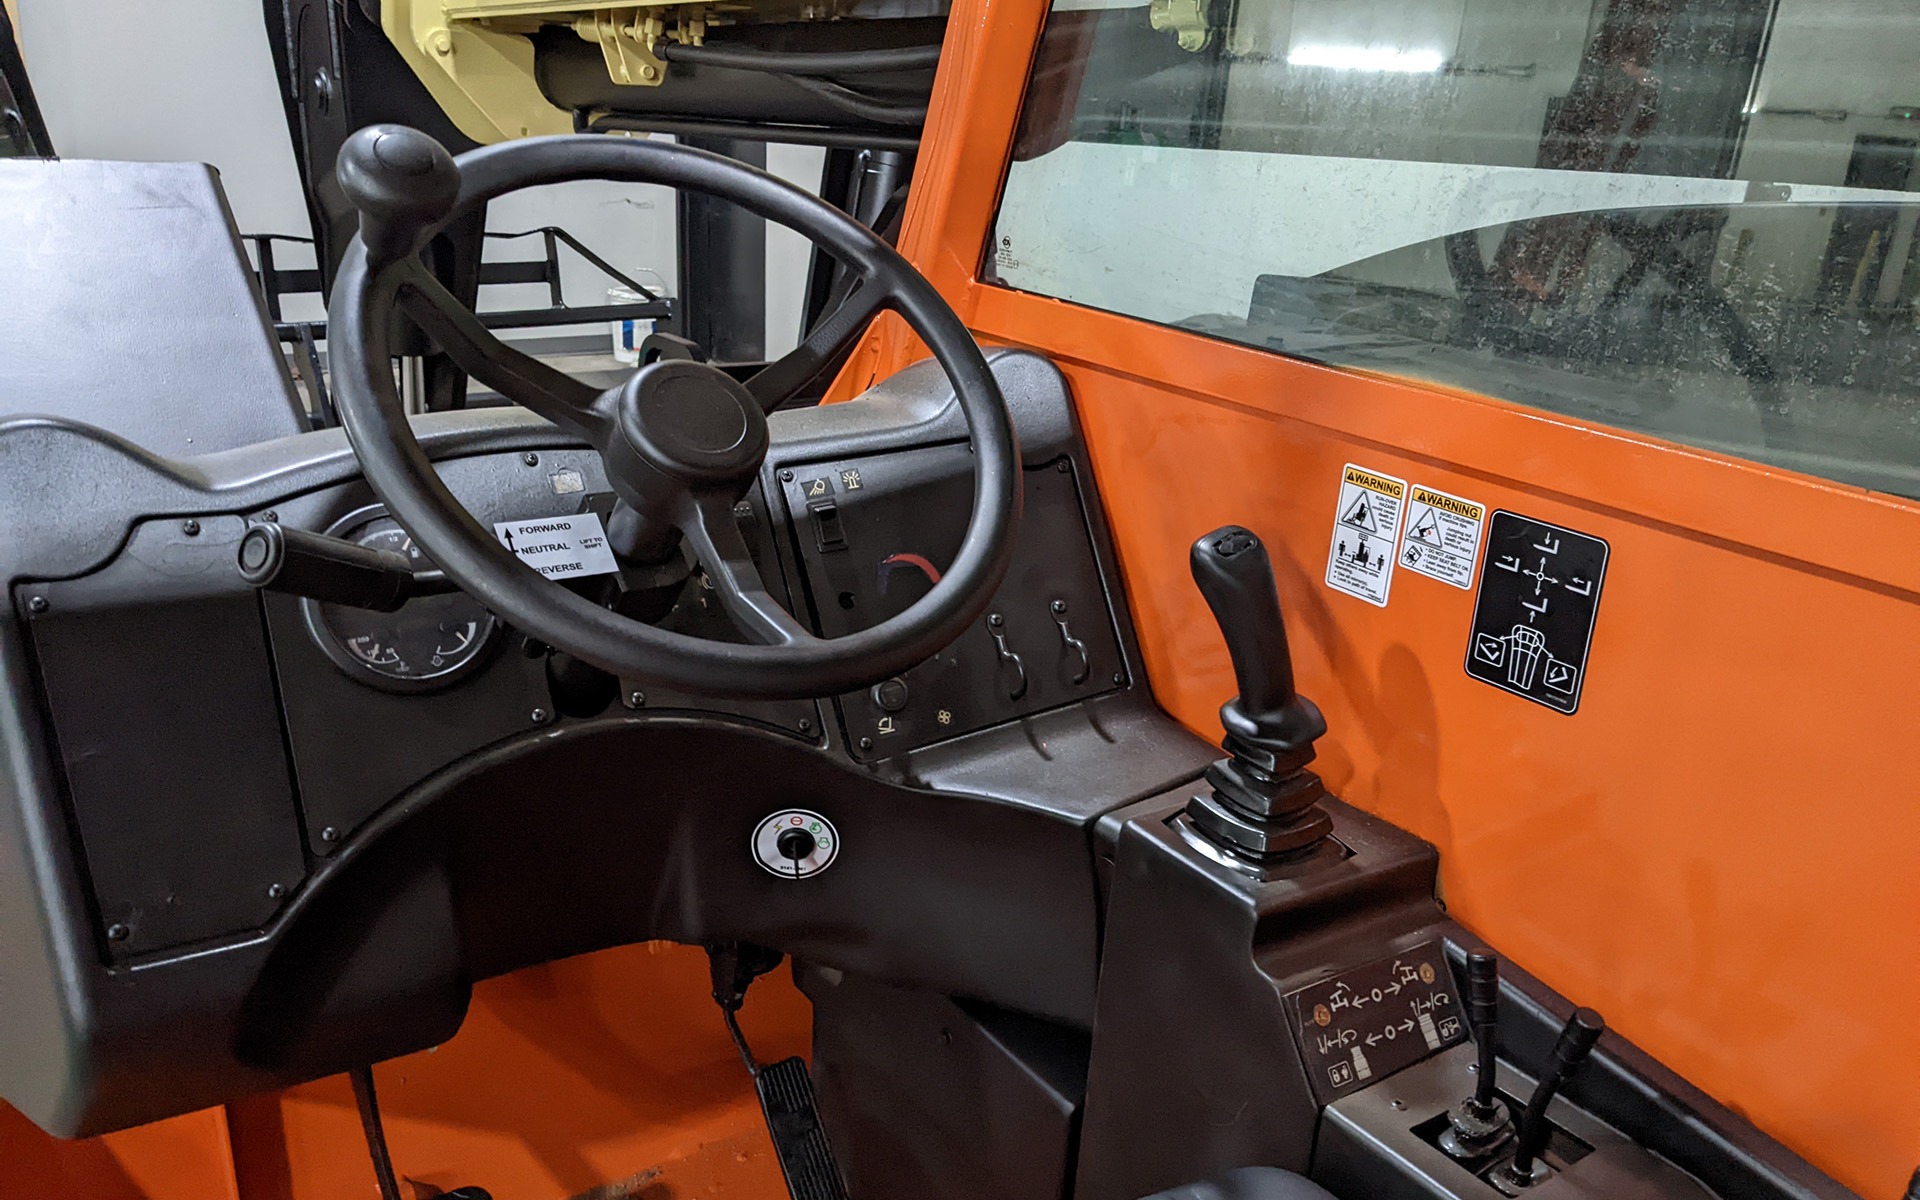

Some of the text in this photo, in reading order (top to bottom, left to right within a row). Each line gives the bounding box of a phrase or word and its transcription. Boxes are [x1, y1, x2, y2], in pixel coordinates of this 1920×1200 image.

[1355, 473, 1401, 496] WARNING
[1375, 495, 1397, 505] RUN-OVER
[1427, 493, 1479, 518] WARNING
[1379, 502, 1396, 511] HAZARD
[1439, 511, 1475, 527] AVOID CRUSHING
[1442, 517, 1458, 526] machine
[518, 522, 572, 535] FORWARD
[1446, 527, 1464, 538] Jumping
[579, 537, 592, 545] LIFT
[584, 542, 602, 550] SHIFT
[521, 542, 571, 555] NEUTRAL
[1443, 541, 1472, 555] serious injury
[1427, 553, 1438, 561] KEEP
[1450, 561, 1461, 569] BELT
[1425, 564, 1436, 572] Brace
[1436, 563, 1447, 571] away
